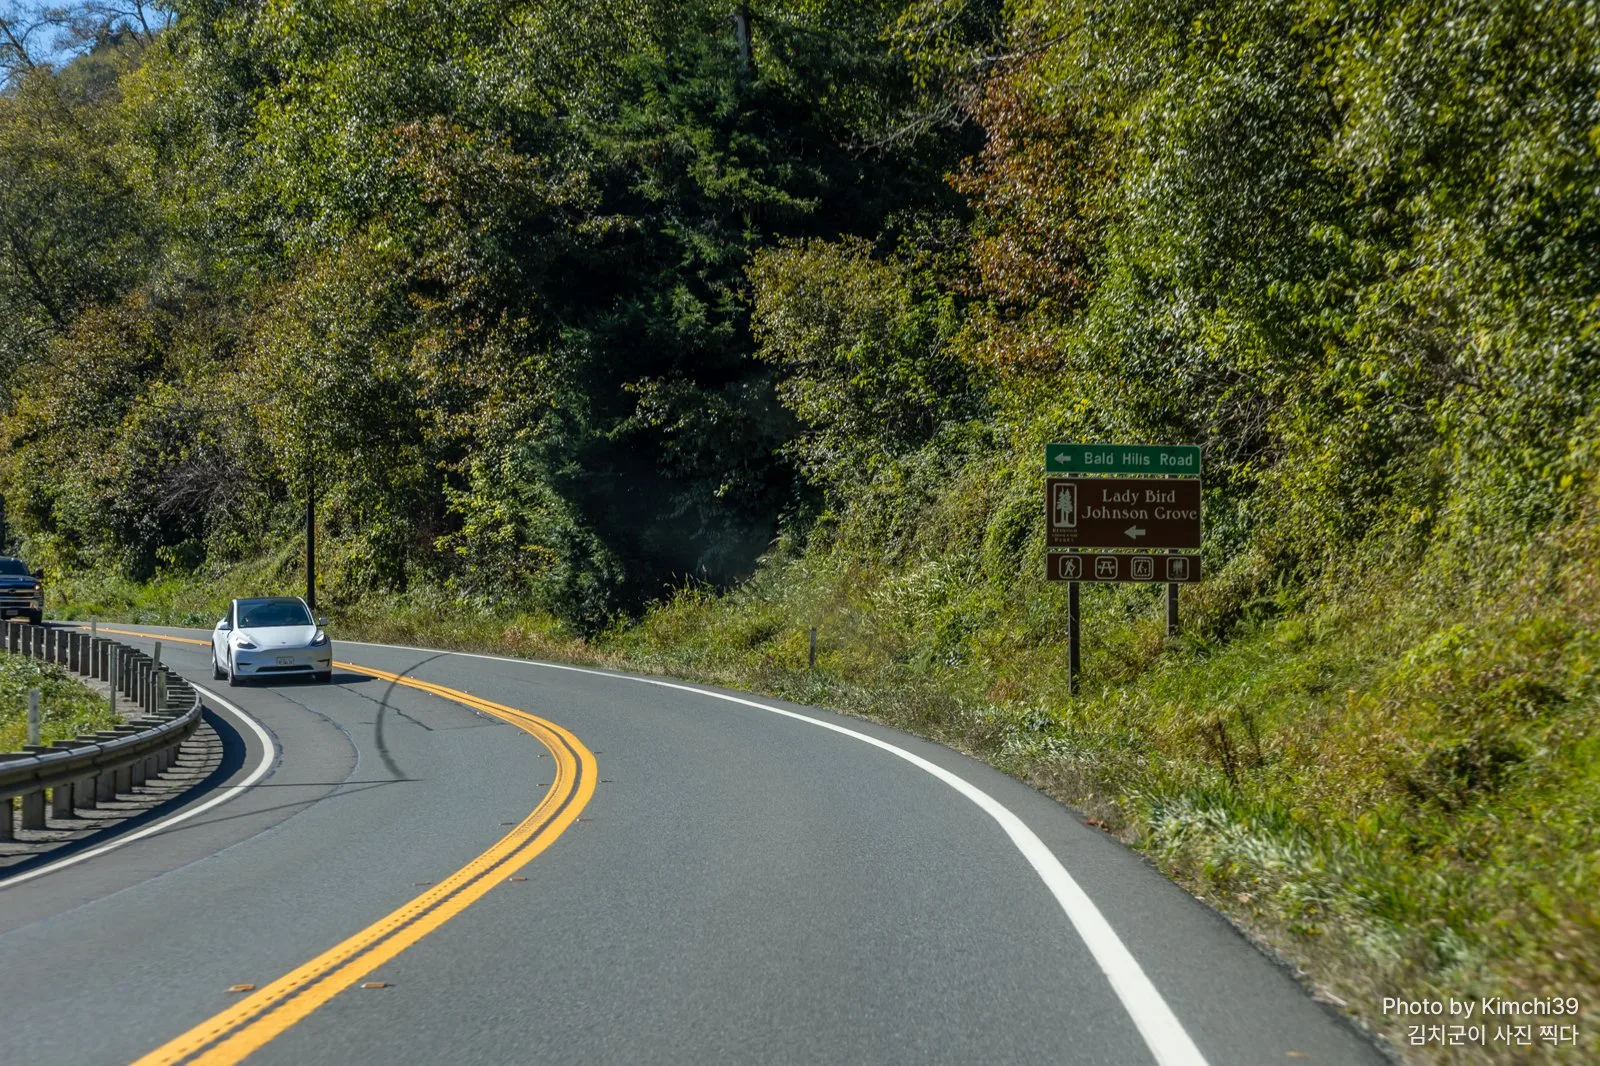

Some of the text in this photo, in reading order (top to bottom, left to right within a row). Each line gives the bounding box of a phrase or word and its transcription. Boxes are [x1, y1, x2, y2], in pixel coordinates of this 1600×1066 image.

[1084, 452, 1193, 466] Bald Hills Road
[1102, 489, 1176, 505] Lady Bird
[1081, 506, 1198, 520] Johnson Grove
